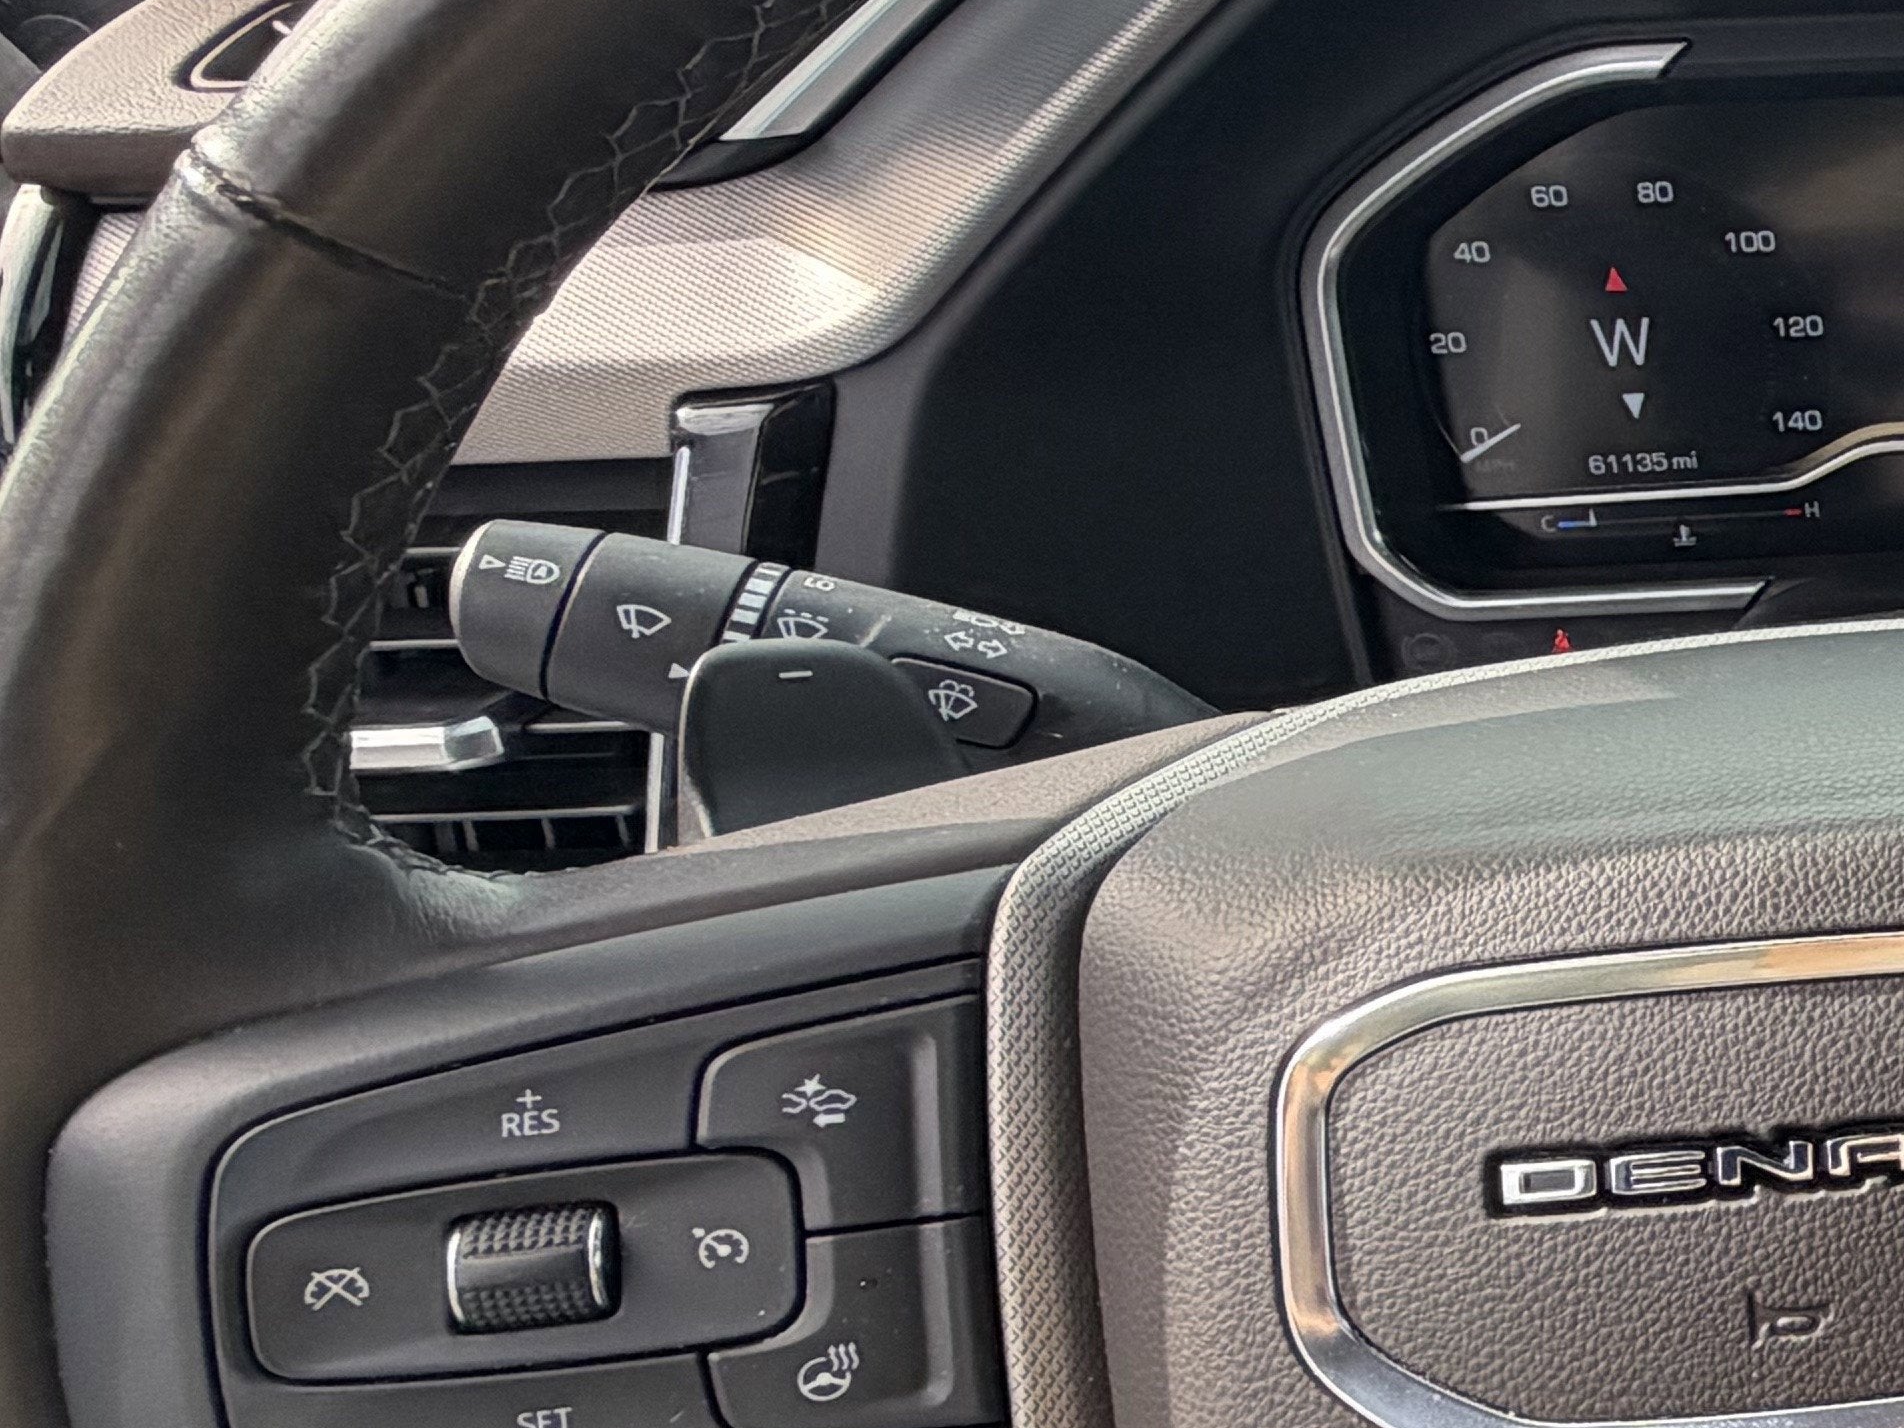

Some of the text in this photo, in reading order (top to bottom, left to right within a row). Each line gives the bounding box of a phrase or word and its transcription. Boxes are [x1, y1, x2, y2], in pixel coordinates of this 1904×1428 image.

[1530, 185, 1569, 208] 60
[1636, 181, 1675, 204] 80
[1453, 240, 1492, 264] 40
[1724, 230, 1777, 254] 100
[1772, 315, 1825, 338] 120
[1429, 332, 1468, 356] 20
[1589, 316, 1651, 367] W
[1771, 410, 1823, 434] 140
[1588, 449, 1699, 476] 61135 mi
[1804, 502, 1820, 519] H
[1540, 514, 1557, 533] C
[501, 1109, 561, 1137] RES
